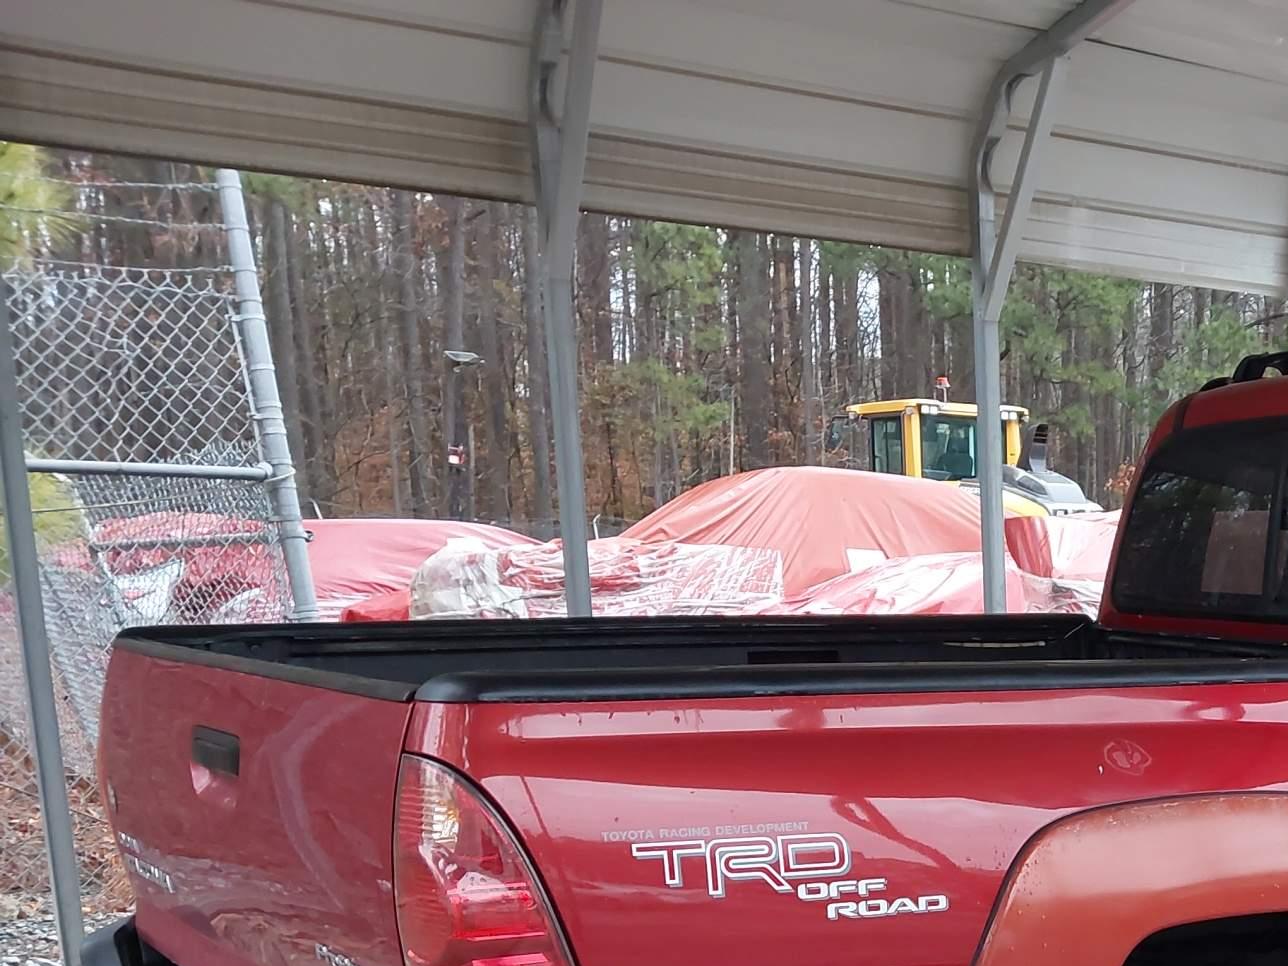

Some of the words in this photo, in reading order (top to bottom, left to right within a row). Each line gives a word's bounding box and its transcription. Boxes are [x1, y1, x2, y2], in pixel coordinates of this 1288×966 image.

[601, 829, 652, 842] TOYOTA
[659, 825, 710, 838] RACING
[716, 821, 809, 835] DEVELOPMENT
[631, 833, 850, 898] TRD
[798, 878, 887, 900] OFF
[826, 895, 948, 920] ROAD
